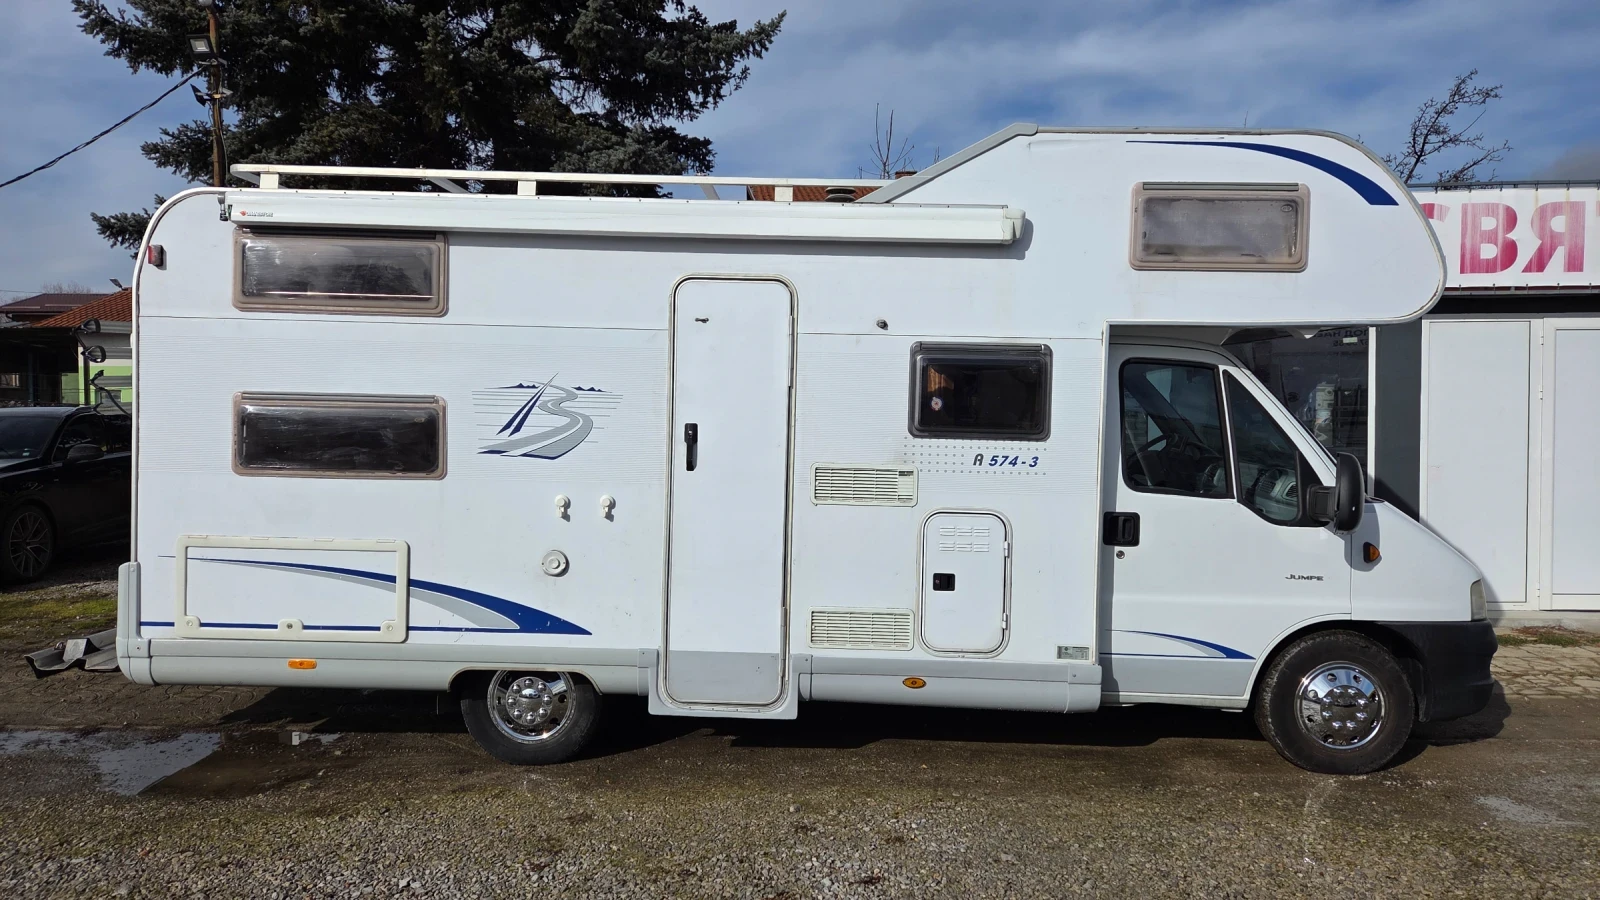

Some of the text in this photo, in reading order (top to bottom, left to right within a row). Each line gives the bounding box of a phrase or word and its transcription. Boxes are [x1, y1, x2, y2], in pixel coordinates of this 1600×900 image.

[1420, 201, 1600, 274] ВЯ
[973, 453, 1039, 467] A 574-3
